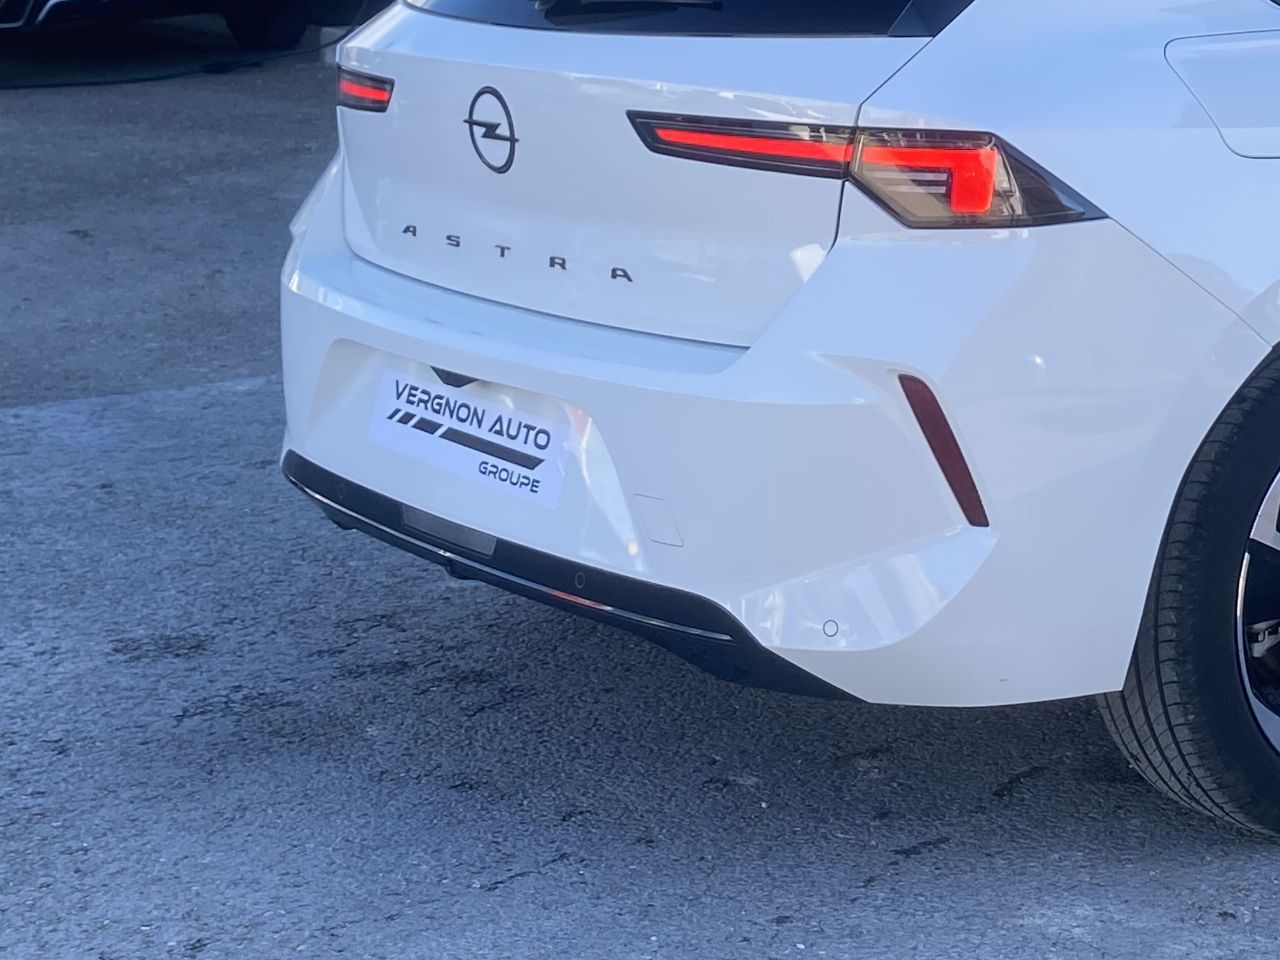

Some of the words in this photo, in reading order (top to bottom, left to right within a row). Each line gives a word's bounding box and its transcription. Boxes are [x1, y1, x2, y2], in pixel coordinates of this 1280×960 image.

[402, 224, 633, 282] ASTRA
[395, 379, 486, 429] VERGNON
[488, 414, 551, 451] AUTO
[479, 460, 541, 494] GROUPE
